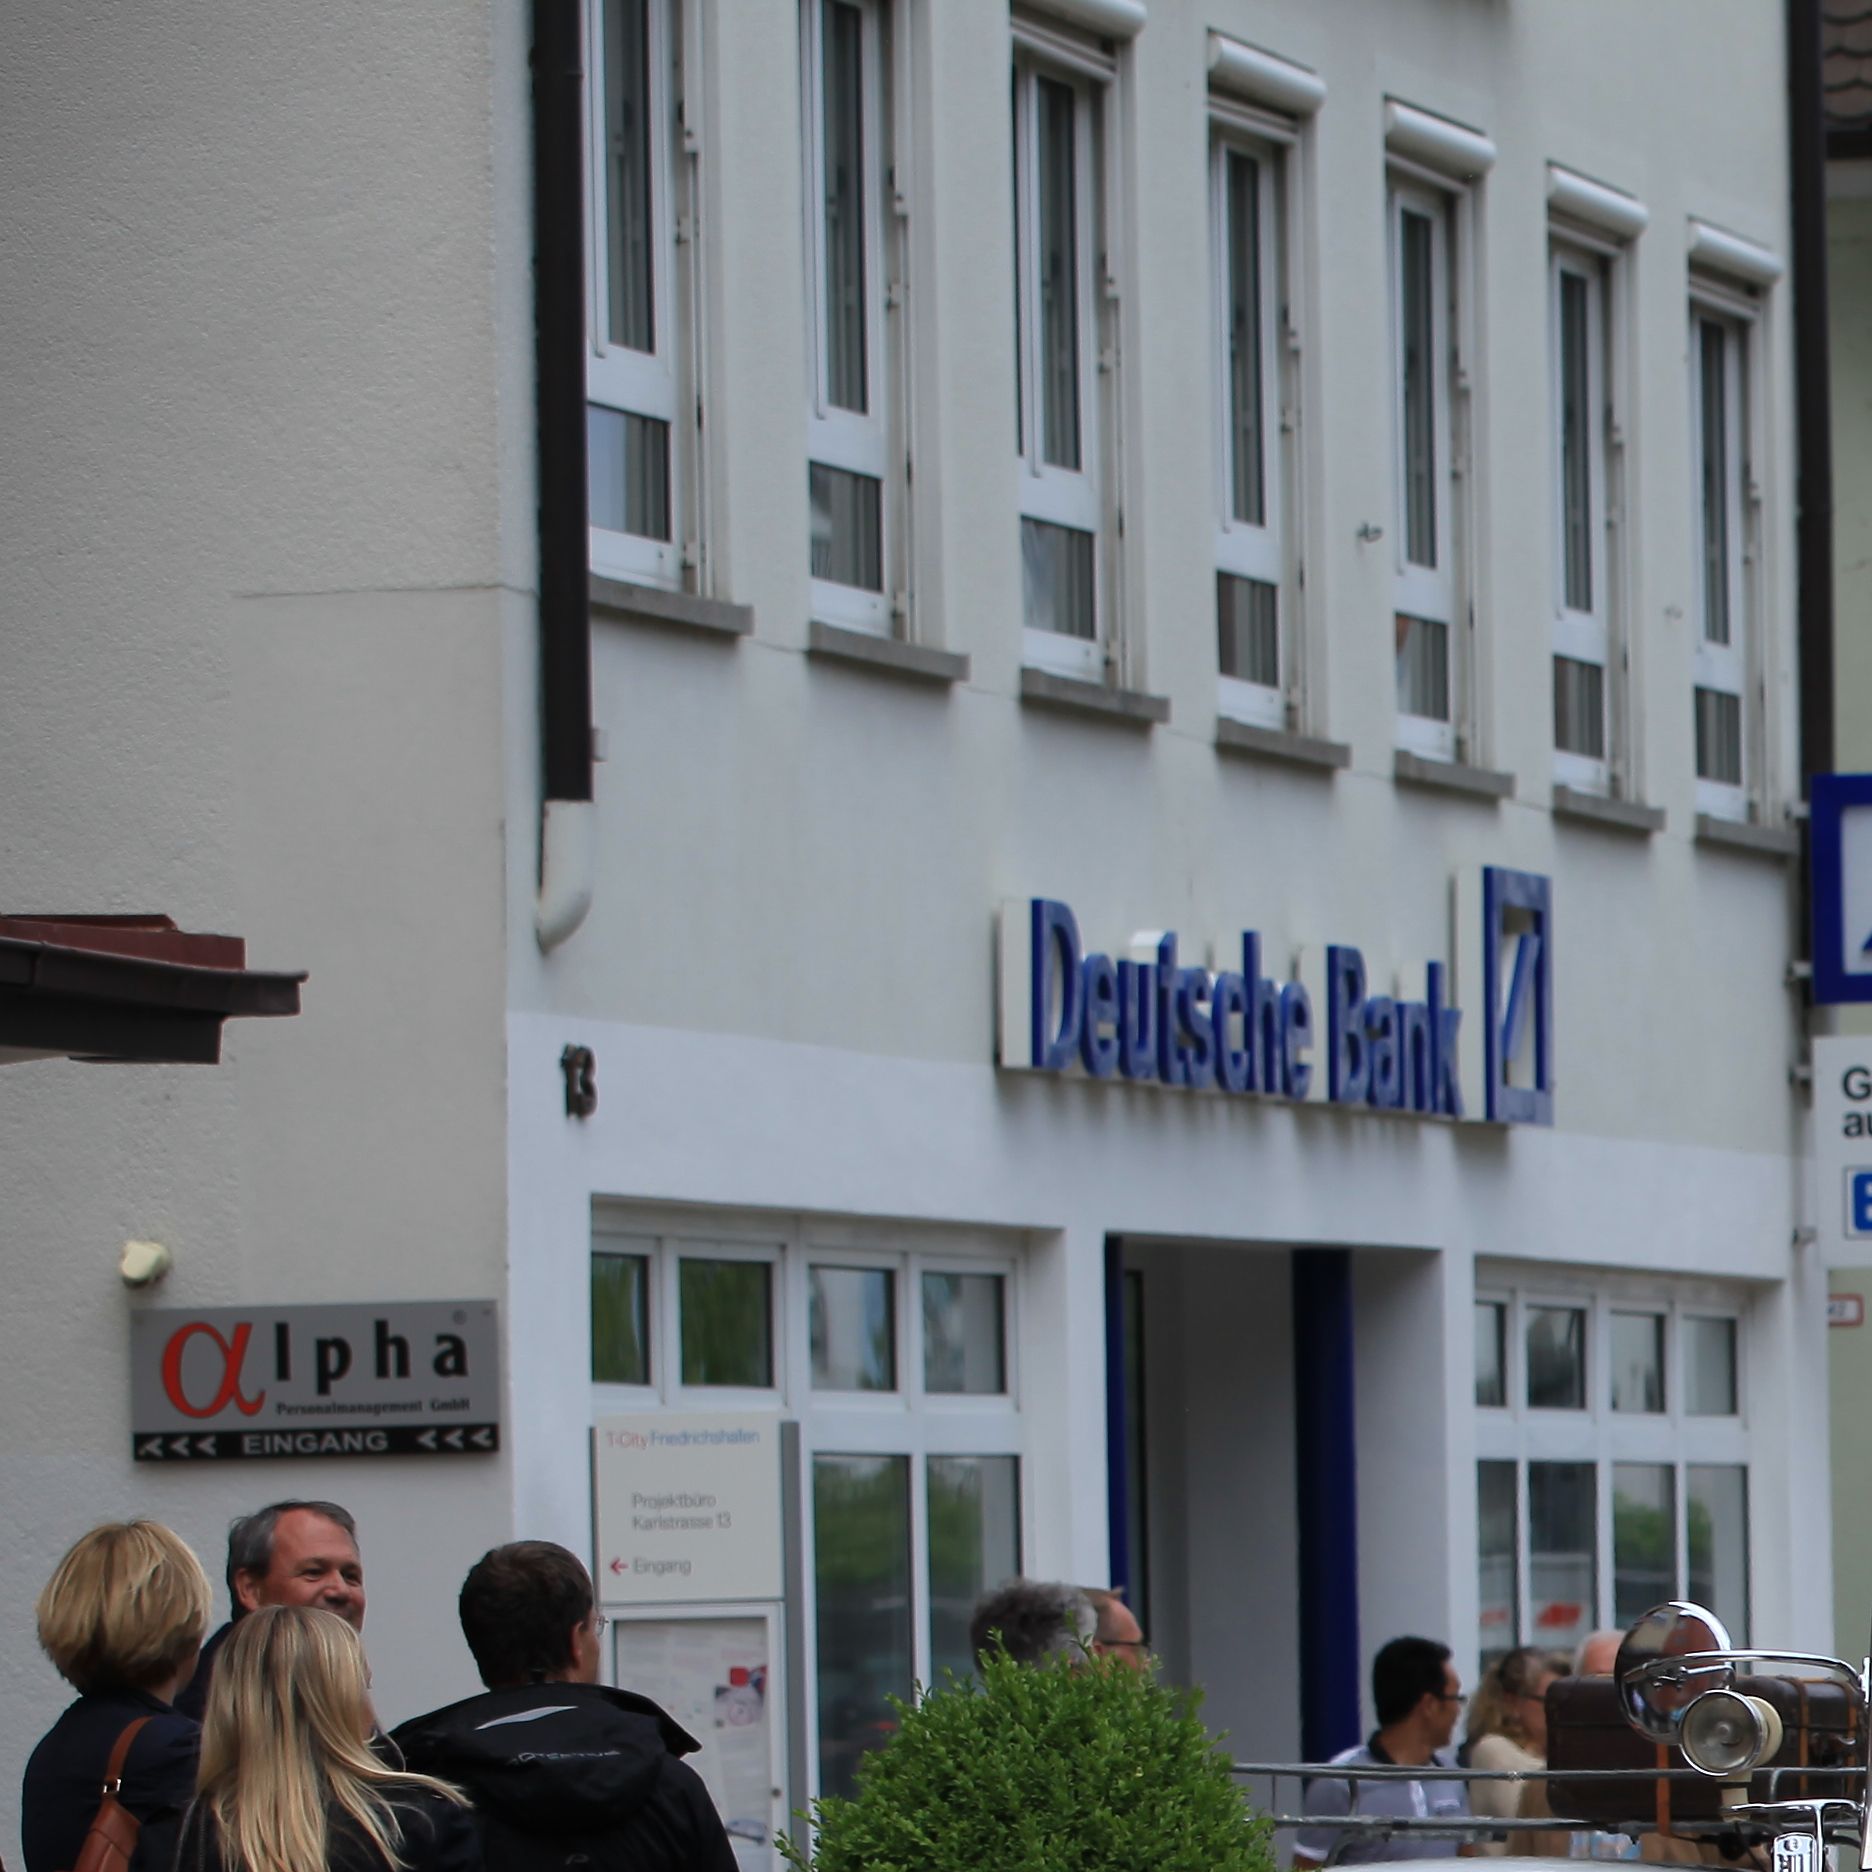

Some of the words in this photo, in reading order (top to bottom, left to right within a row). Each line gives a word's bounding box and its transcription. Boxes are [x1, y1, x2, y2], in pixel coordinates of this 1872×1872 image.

[1031, 897, 1315, 1101] Deutsche
[1327, 944, 1464, 1119] Bank
[275, 1400, 424, 1417] Personalmanagement
[431, 1398, 470, 1412] GmbH
[243, 1430, 389, 1455] EINGANG
[632, 1492, 717, 1510] Projektbüro
[632, 1514, 714, 1531] Karlstrasse
[716, 1512, 732, 1530] 13
[633, 1557, 692, 1576] Eingang
